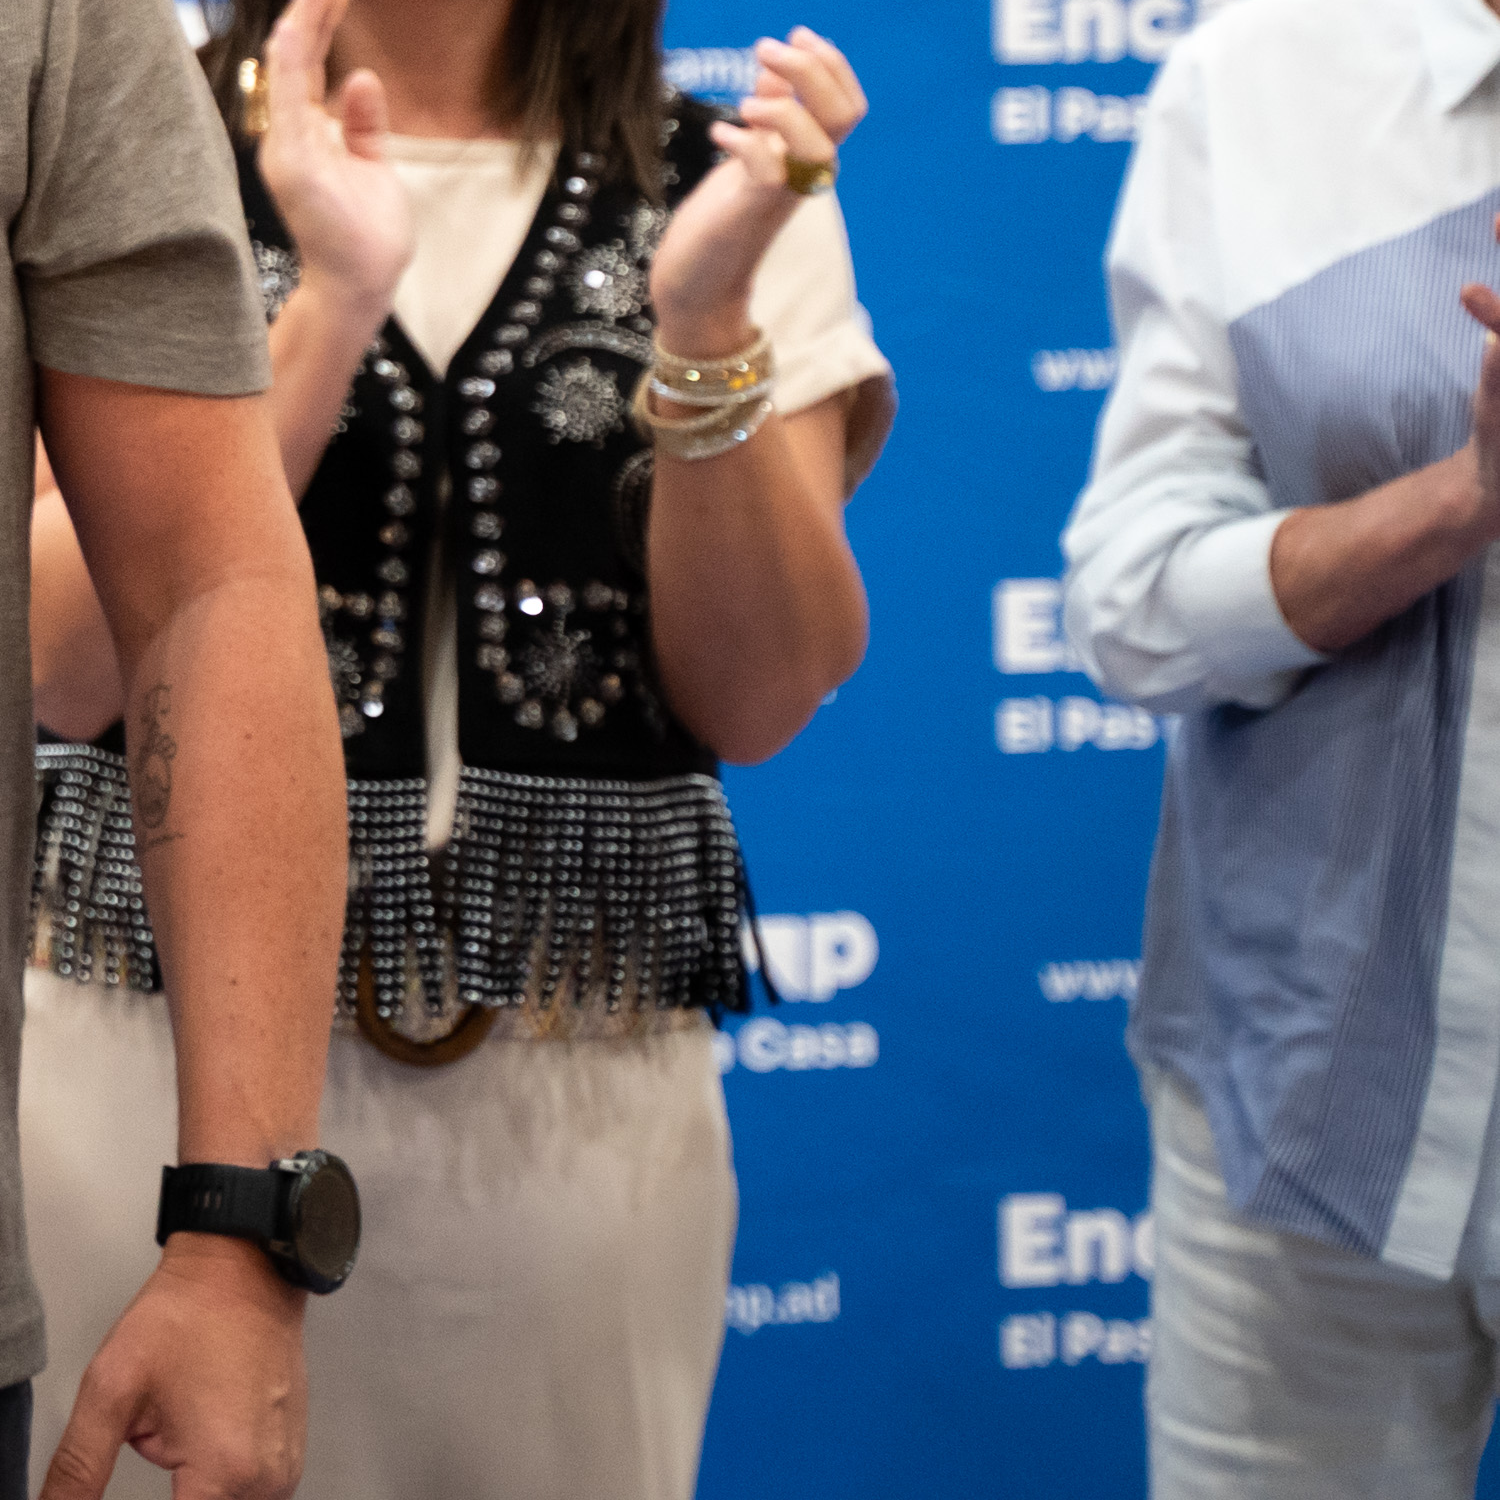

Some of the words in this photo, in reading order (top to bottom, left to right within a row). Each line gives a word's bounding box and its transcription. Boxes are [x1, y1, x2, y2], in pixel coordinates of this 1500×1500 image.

[992, 86, 1051, 143] El
[737, 1017, 879, 1072] Casa
[1000, 1311, 1056, 1368] El
